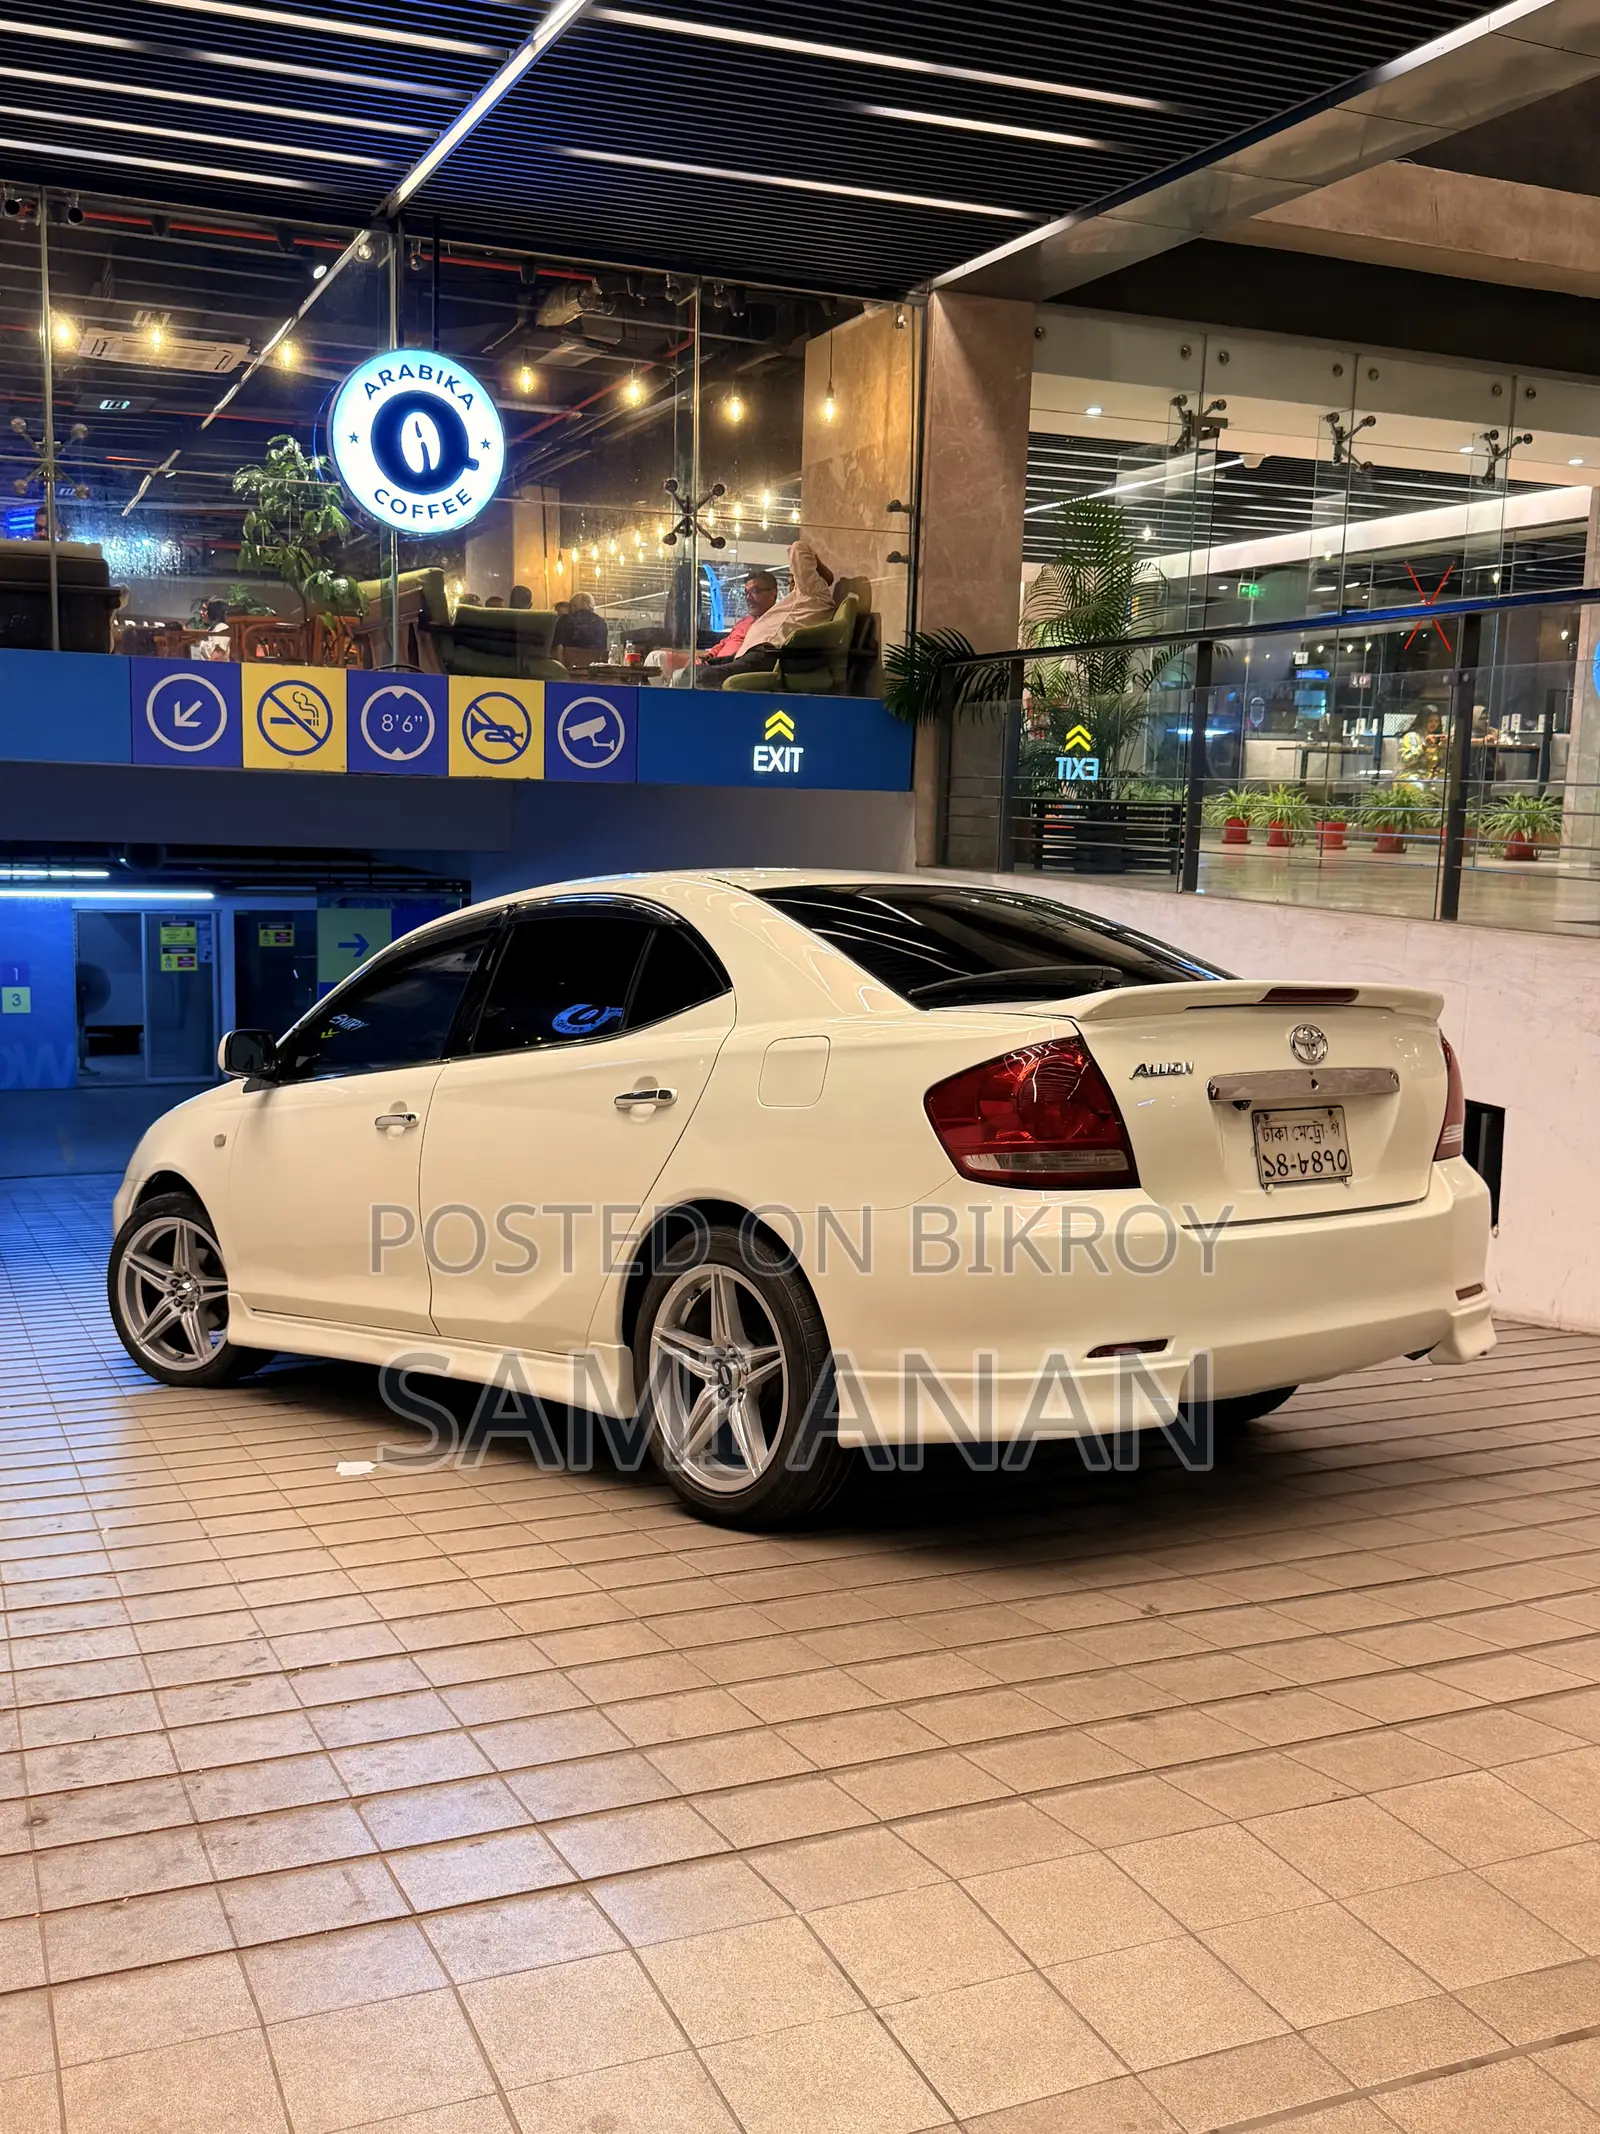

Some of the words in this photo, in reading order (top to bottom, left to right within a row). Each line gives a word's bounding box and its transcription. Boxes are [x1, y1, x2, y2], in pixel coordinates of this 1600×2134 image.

[362, 364, 475, 411] ARABIKA
[374, 488, 472, 519] COFFEE
[753, 745, 805, 773] EXIT
[12, 967, 20, 981] 1
[11, 993, 22, 1007] 3
[1129, 1061, 1194, 1079] ALLION
[1262, 1126, 1289, 1142] ঢাকা
[1262, 1148, 1348, 1177] ১৪-৮৪৭০
